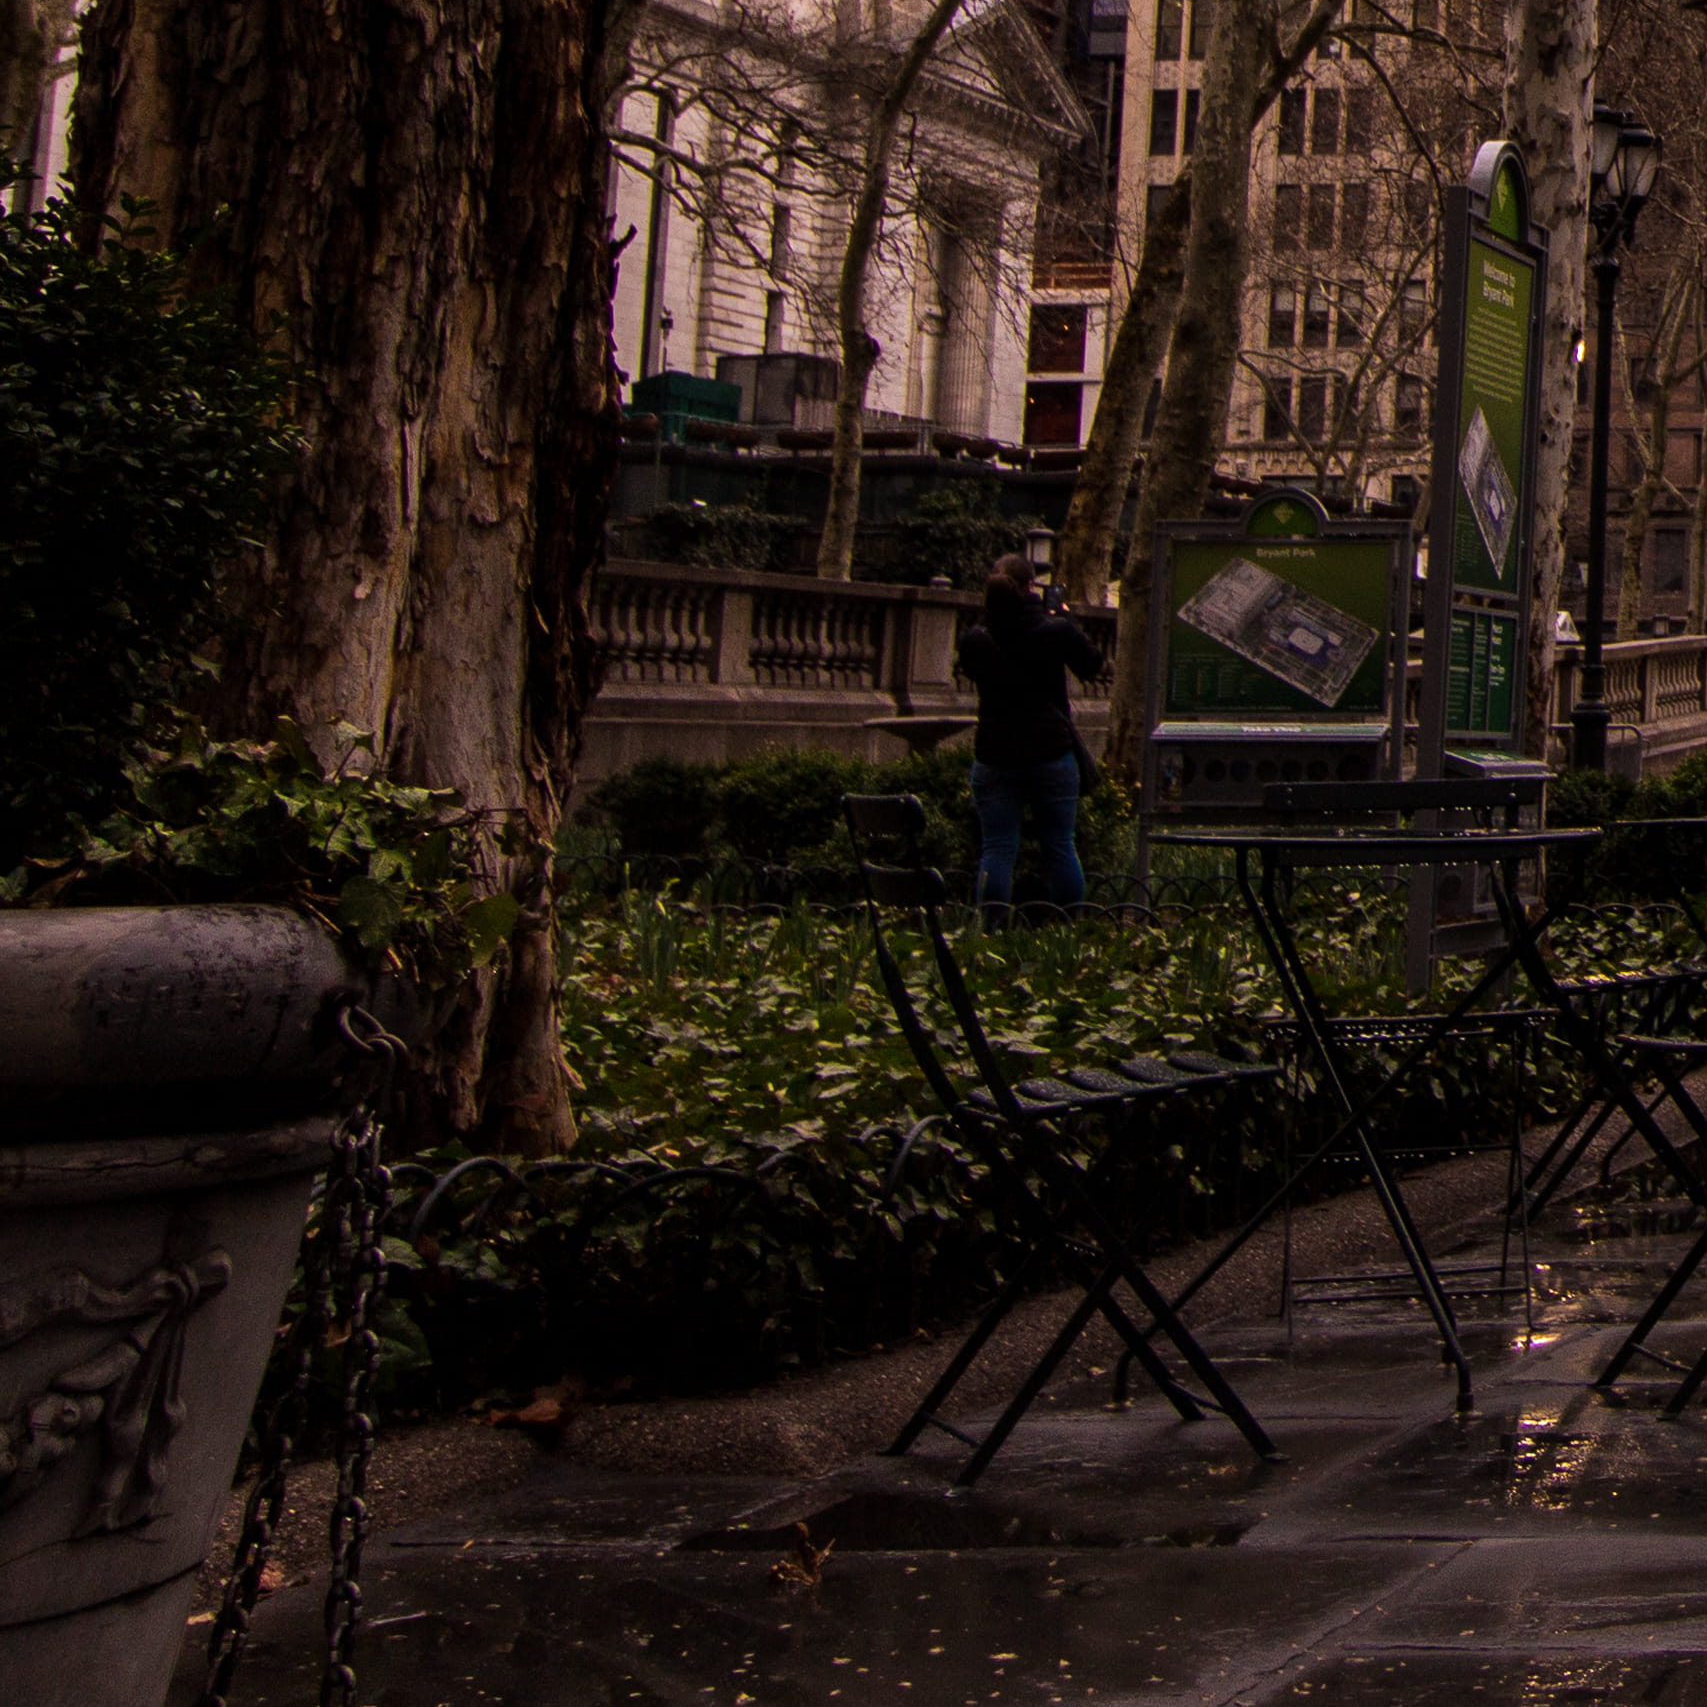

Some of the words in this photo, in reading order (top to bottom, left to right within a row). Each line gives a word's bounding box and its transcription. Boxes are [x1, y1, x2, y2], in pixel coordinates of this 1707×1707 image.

[1483, 260, 1508, 284] Welcome
[1482, 281, 1501, 303] Bryant
[1502, 290, 1514, 308] Park
[1256, 548, 1291, 559] Bryant
[1292, 548, 1317, 557] Park
